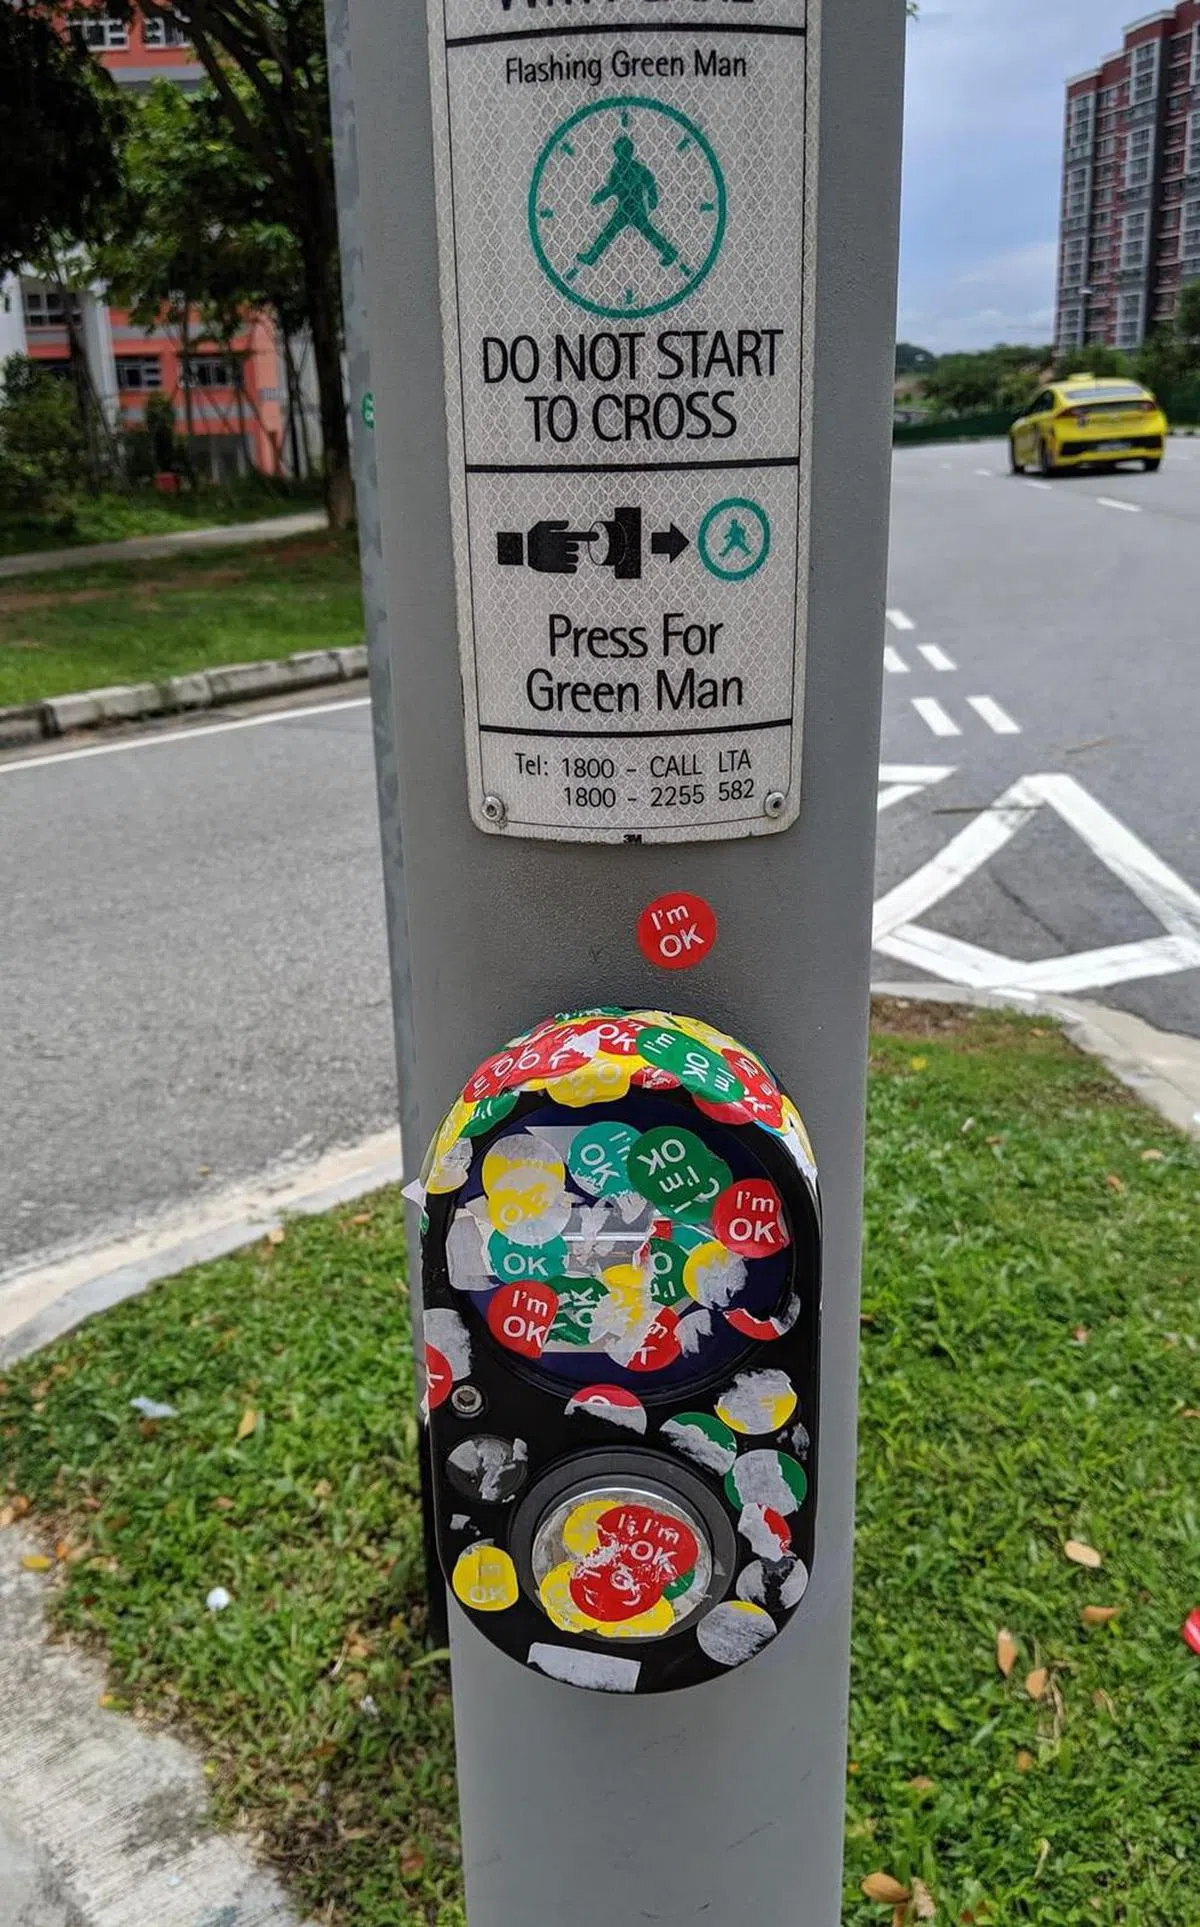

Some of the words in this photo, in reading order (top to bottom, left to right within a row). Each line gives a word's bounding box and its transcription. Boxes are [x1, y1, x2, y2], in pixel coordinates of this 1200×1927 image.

[506, 54, 601, 86] Flashing
[611, 50, 684, 78] Green
[695, 50, 747, 77] Man
[482, 335, 539, 384] DO
[555, 332, 646, 383] NOT
[657, 329, 784, 380] START
[525, 395, 578, 443] TO
[592, 391, 738, 442] CROSS
[549, 614, 648, 659] Press
[662, 613, 724, 656] For
[526, 668, 640, 713] Green
[656, 668, 743, 711] Man
[515, 752, 549, 776] Tel:
[561, 758, 615, 779] 1800
[650, 754, 702, 778] CALL
[718, 749, 752, 772] LTA
[564, 787, 616, 808] 1800
[651, 784, 705, 808] 2255
[718, 779, 755, 802] 582
[651, 905, 689, 931] I'm
[660, 922, 705, 958] OK
[597, 1024, 637, 1052] OK
[644, 1033, 677, 1054] I'm
[682, 1052, 710, 1083] OK
[579, 1143, 620, 1190] OK
[637, 1138, 686, 1176] OK
[658, 1166, 700, 1193] I'm
[736, 1190, 775, 1213] I'm
[729, 1217, 776, 1244] OK
[503, 1252, 549, 1277] OK
[512, 1290, 548, 1318] I'm
[503, 1315, 547, 1347] OK
[630, 1540, 678, 1575] OK
